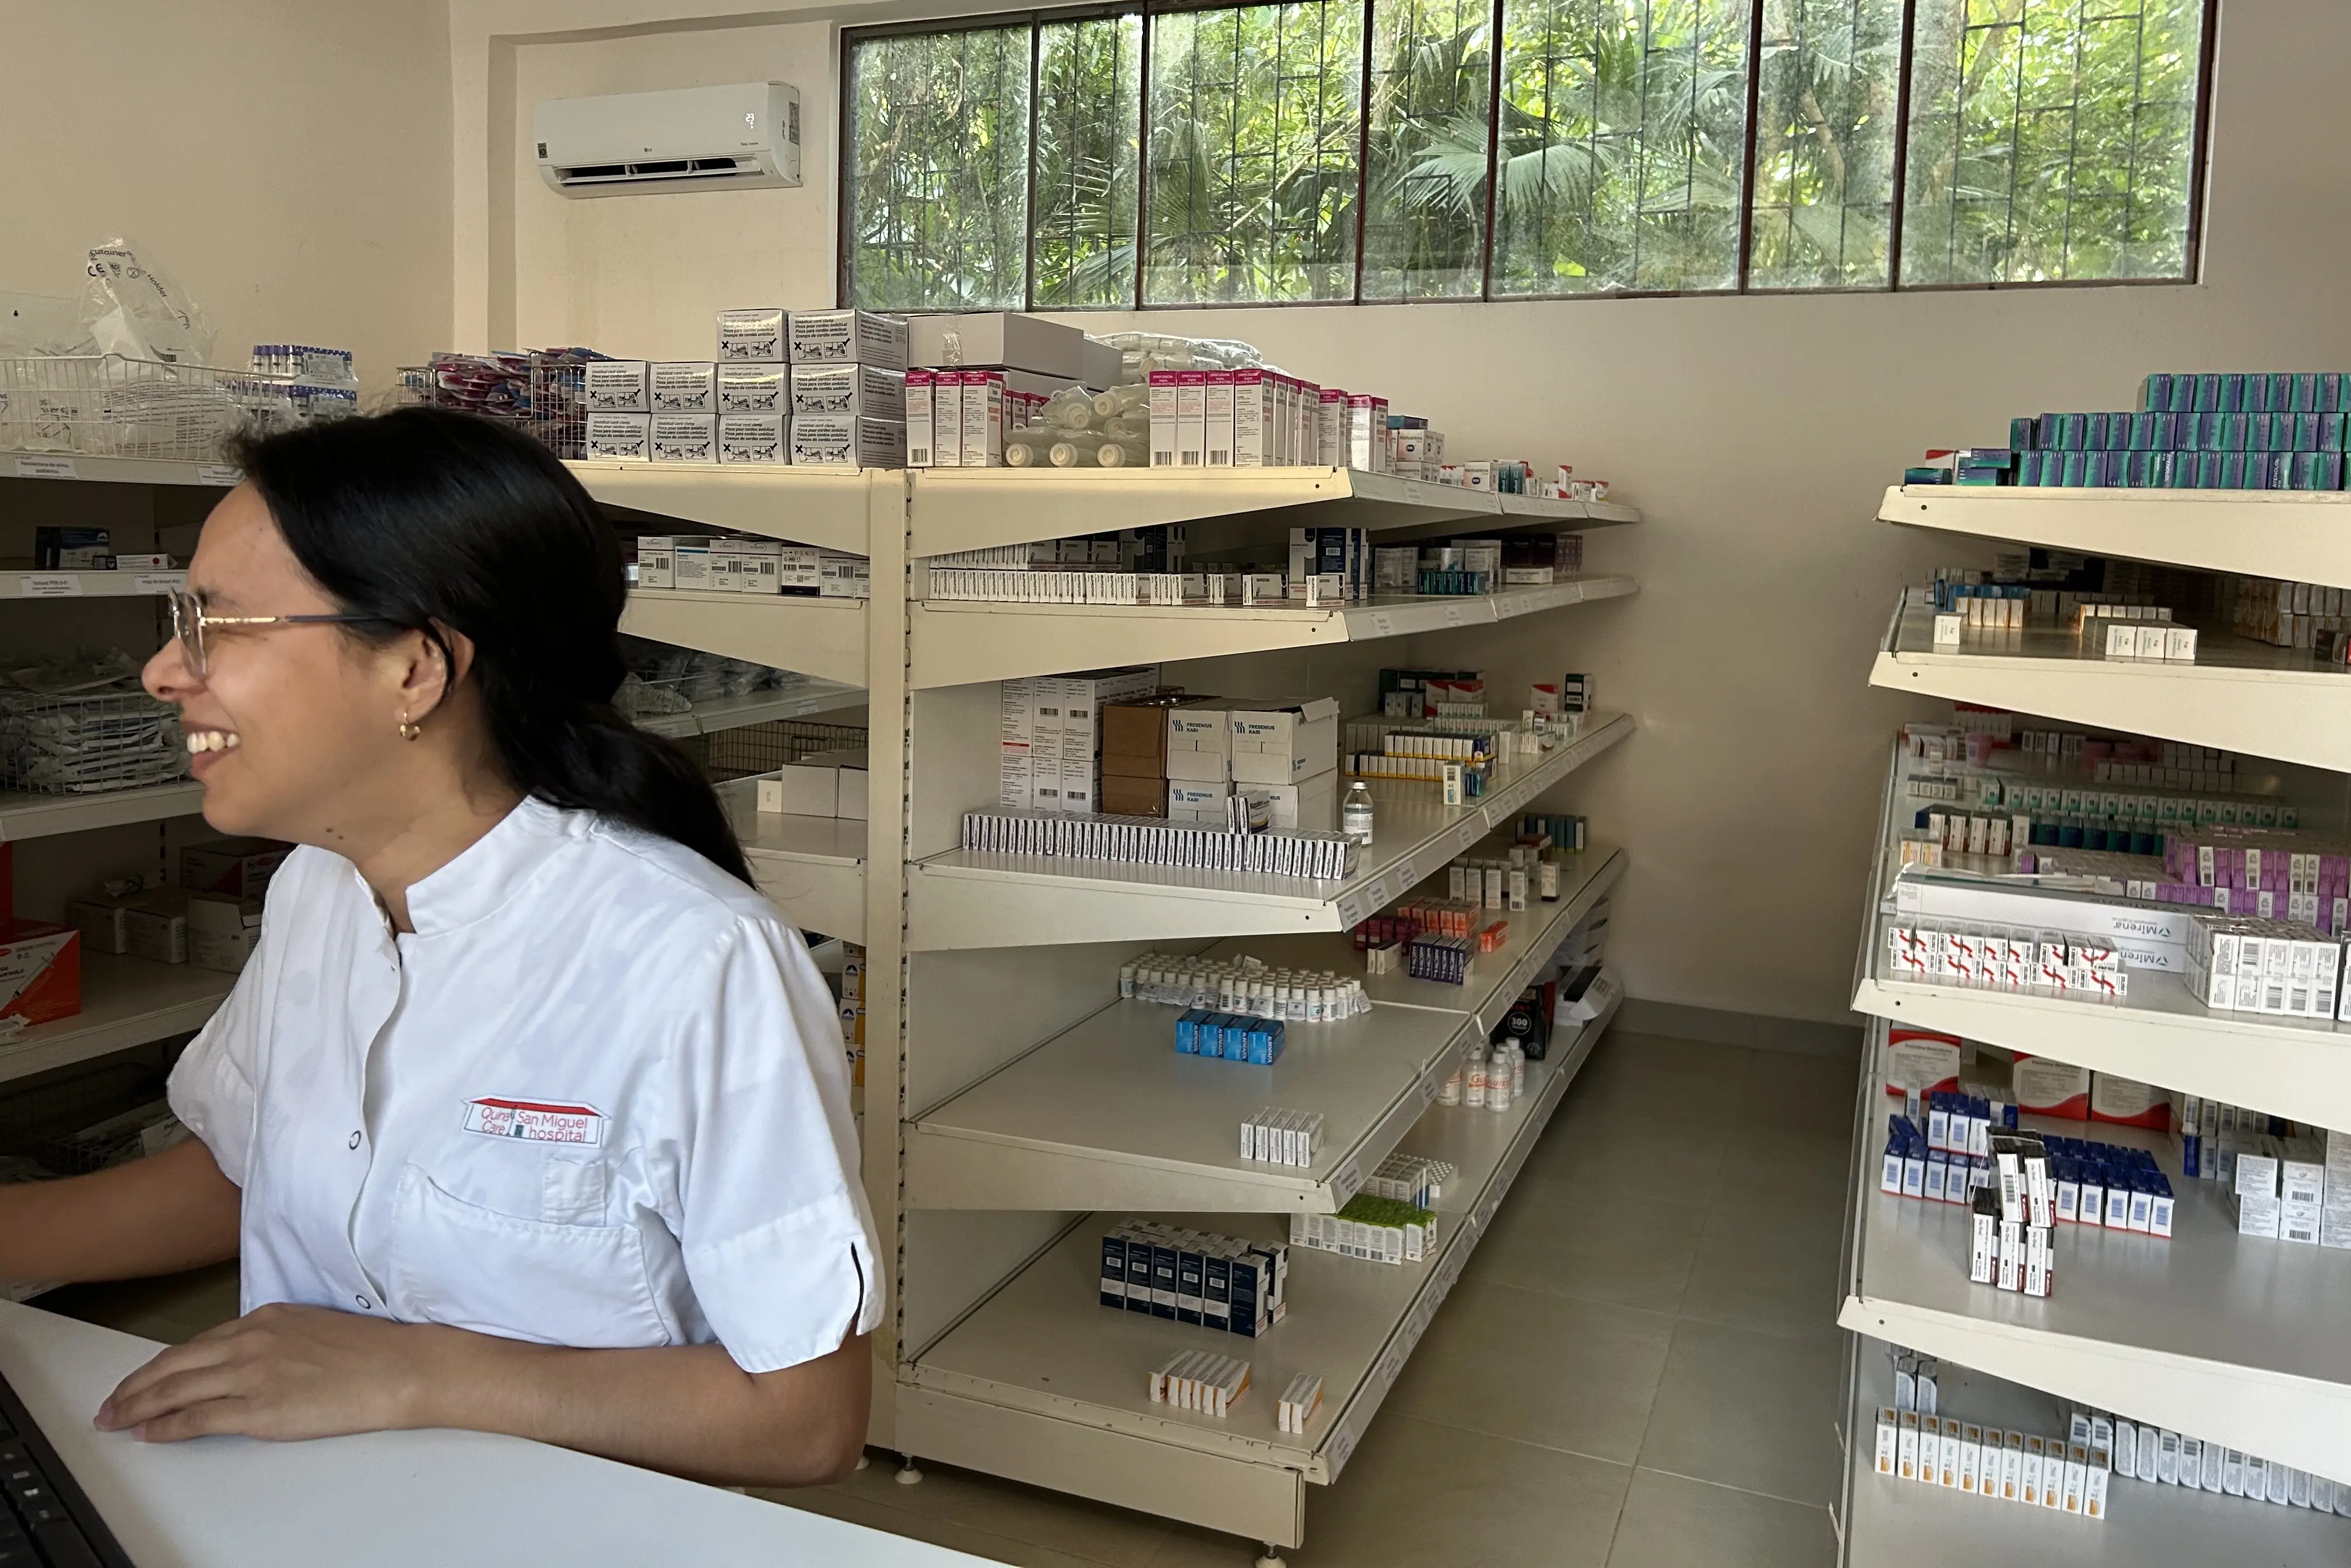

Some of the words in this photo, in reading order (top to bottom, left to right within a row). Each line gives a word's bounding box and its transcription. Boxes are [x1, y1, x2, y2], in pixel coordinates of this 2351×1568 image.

[2116, 922, 2157, 935] Mirena
[2120, 951, 2154, 964] Miren
[1511, 1017, 1528, 1026] 300
[482, 1107, 510, 1121] Quina
[517, 1111, 538, 1126] San
[542, 1114, 588, 1130] Miguel
[483, 1120, 505, 1134] Care
[529, 1127, 587, 1142] hospital
